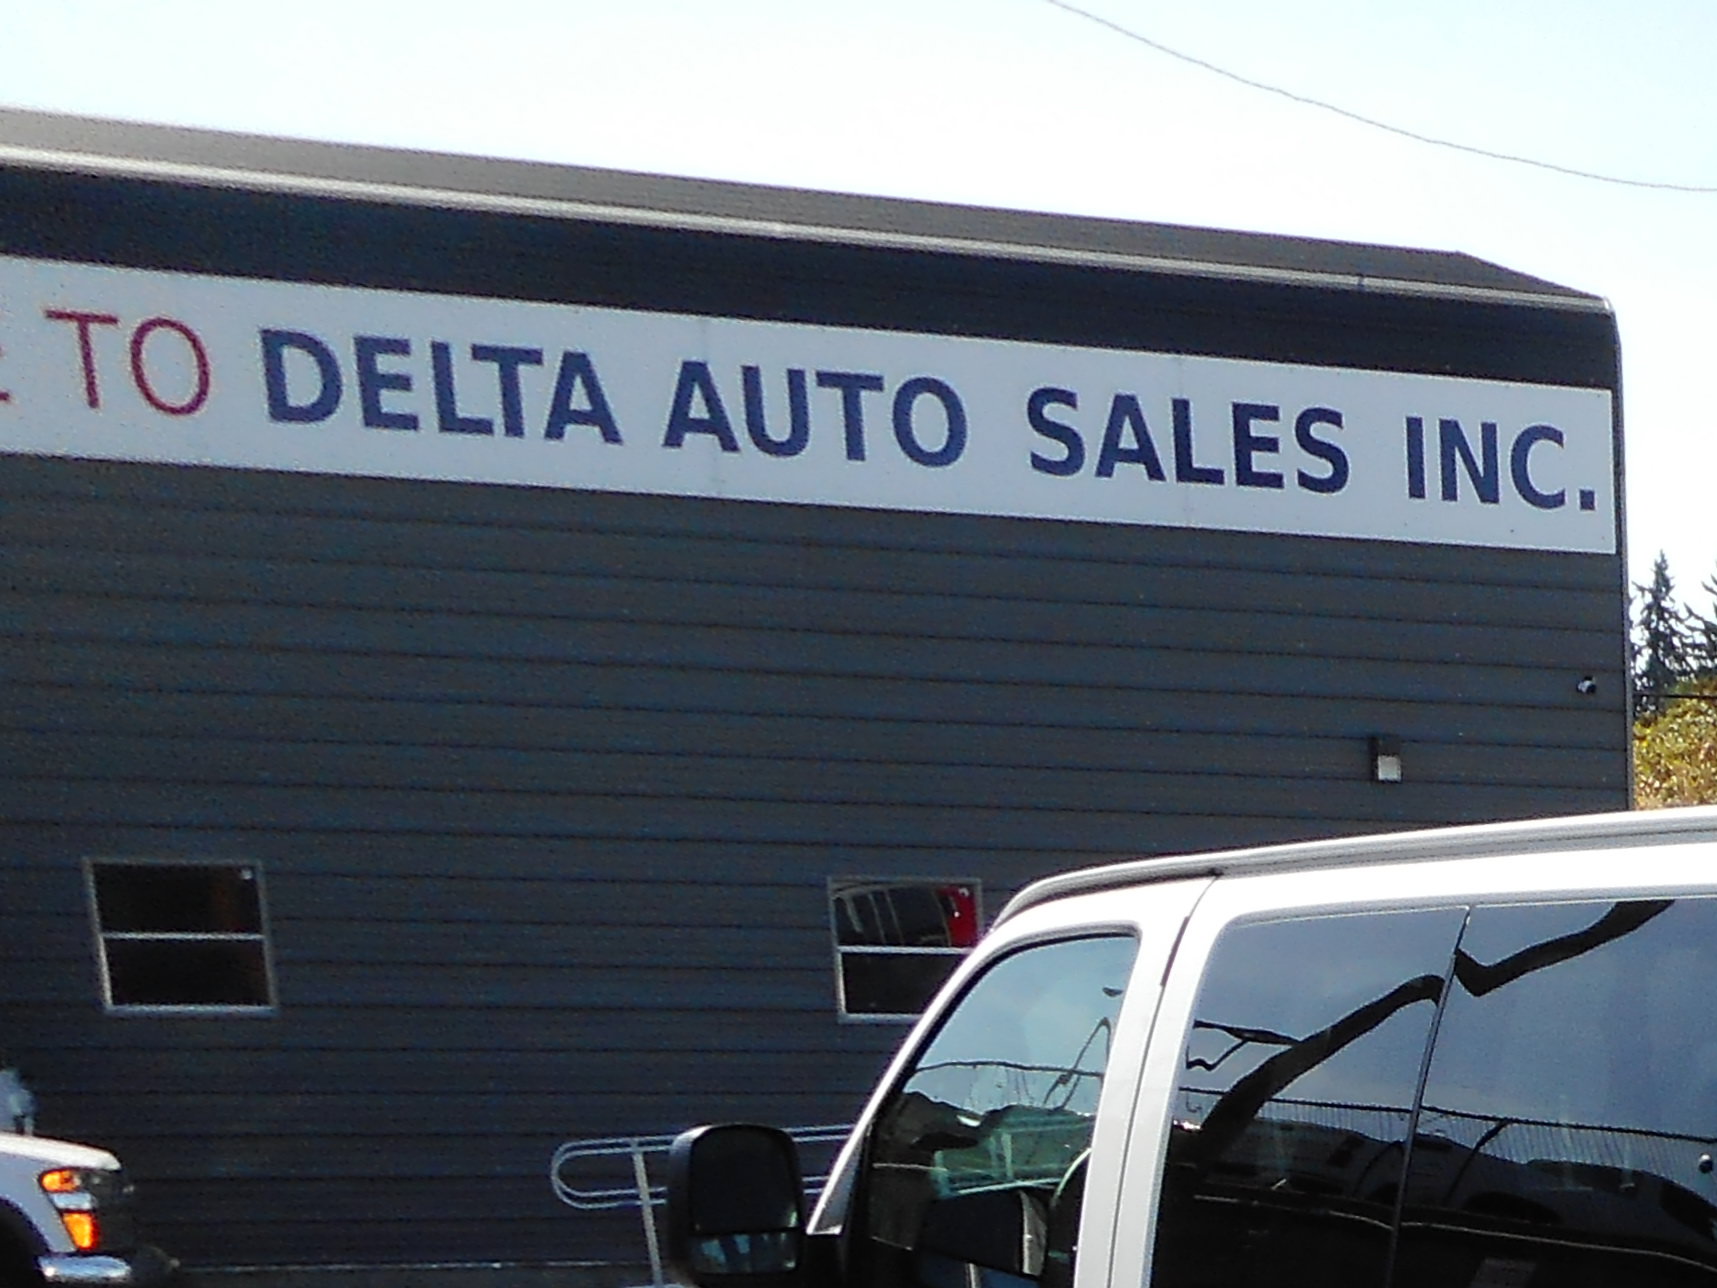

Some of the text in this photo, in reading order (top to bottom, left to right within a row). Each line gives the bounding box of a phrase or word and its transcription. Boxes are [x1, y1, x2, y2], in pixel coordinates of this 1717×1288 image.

[43, 307, 212, 416] TO
[258, 326, 624, 446] DELTA
[662, 360, 968, 469] AUTO
[1026, 386, 1350, 496] SALES
[1405, 415, 1598, 512] INC.
